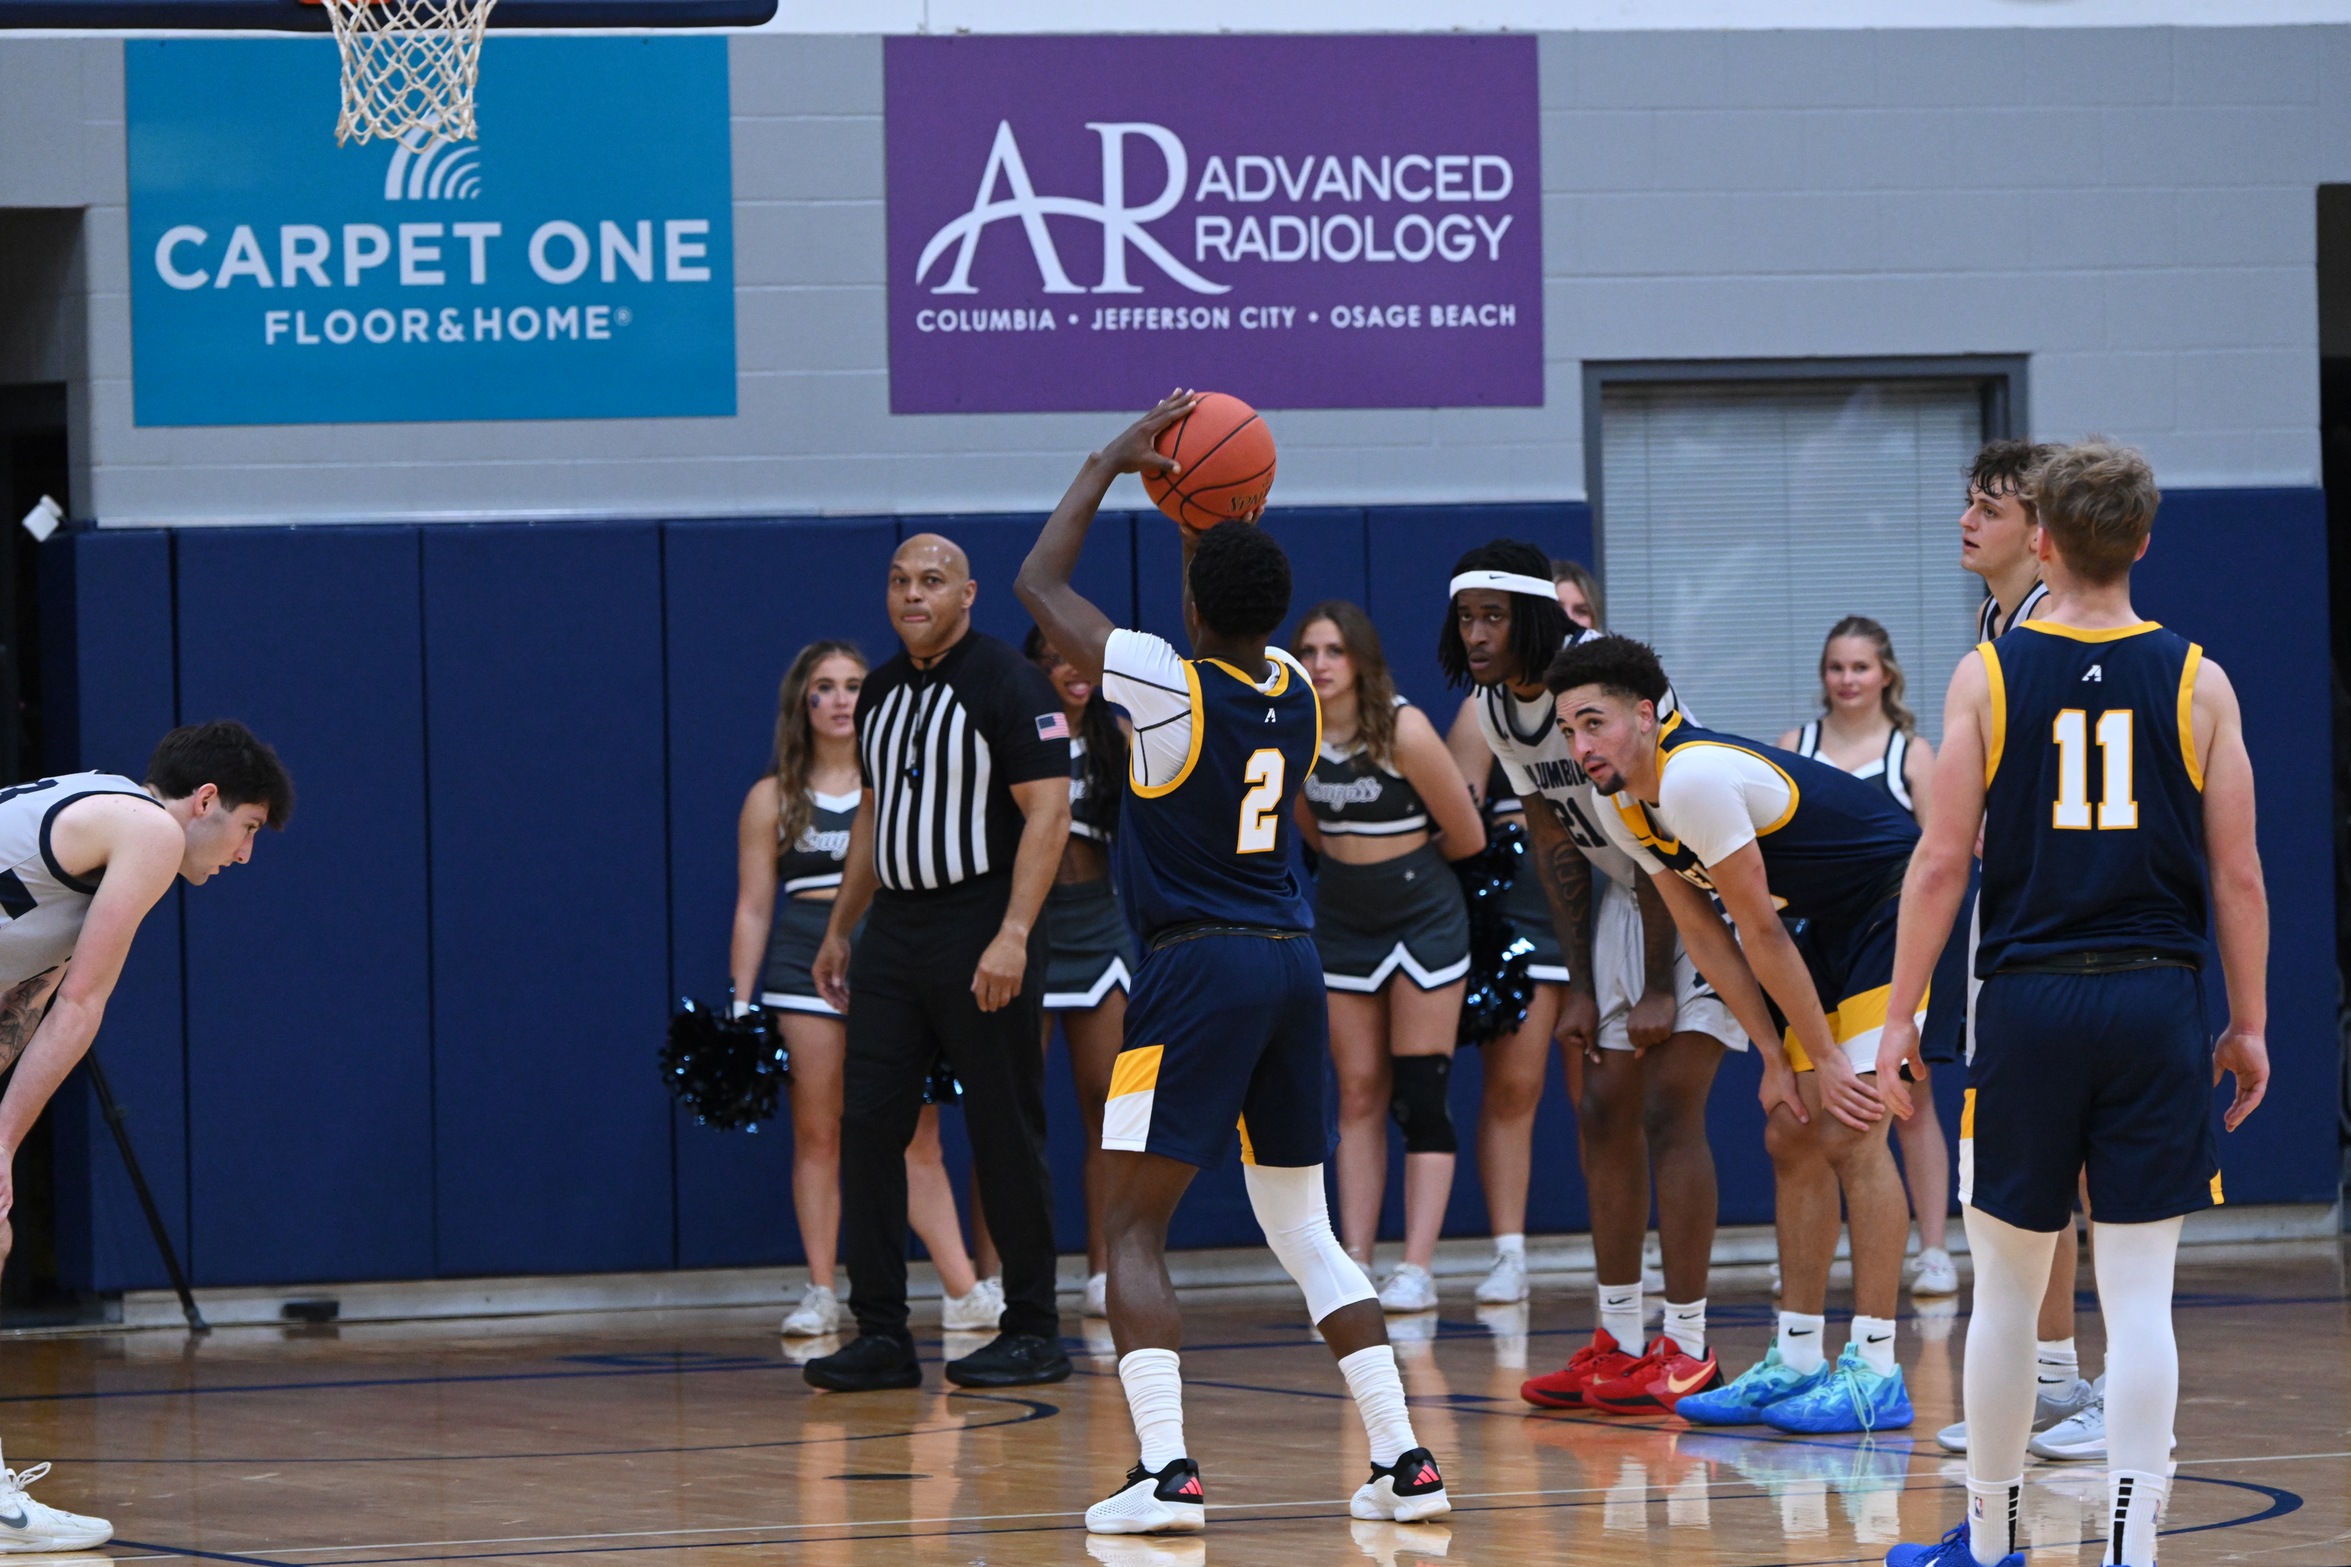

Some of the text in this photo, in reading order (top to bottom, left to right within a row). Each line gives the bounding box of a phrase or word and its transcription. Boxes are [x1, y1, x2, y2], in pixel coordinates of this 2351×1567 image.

[1195, 154, 1514, 203] ADVANCED
[154, 219, 711, 290] CARPET ONE
[1195, 213, 1514, 263] RADIOLOGY
[915, 308, 1056, 333] COLUMBIA
[1090, 305, 1297, 331] JEFFERSON CITY
[1329, 303, 1517, 329] OSAGE BEACH
[1522, 759, 1588, 790] LUMBIA
[2052, 708, 2138, 830] 11
[1236, 748, 1285, 854] 2
[1546, 797, 1608, 848] 21
